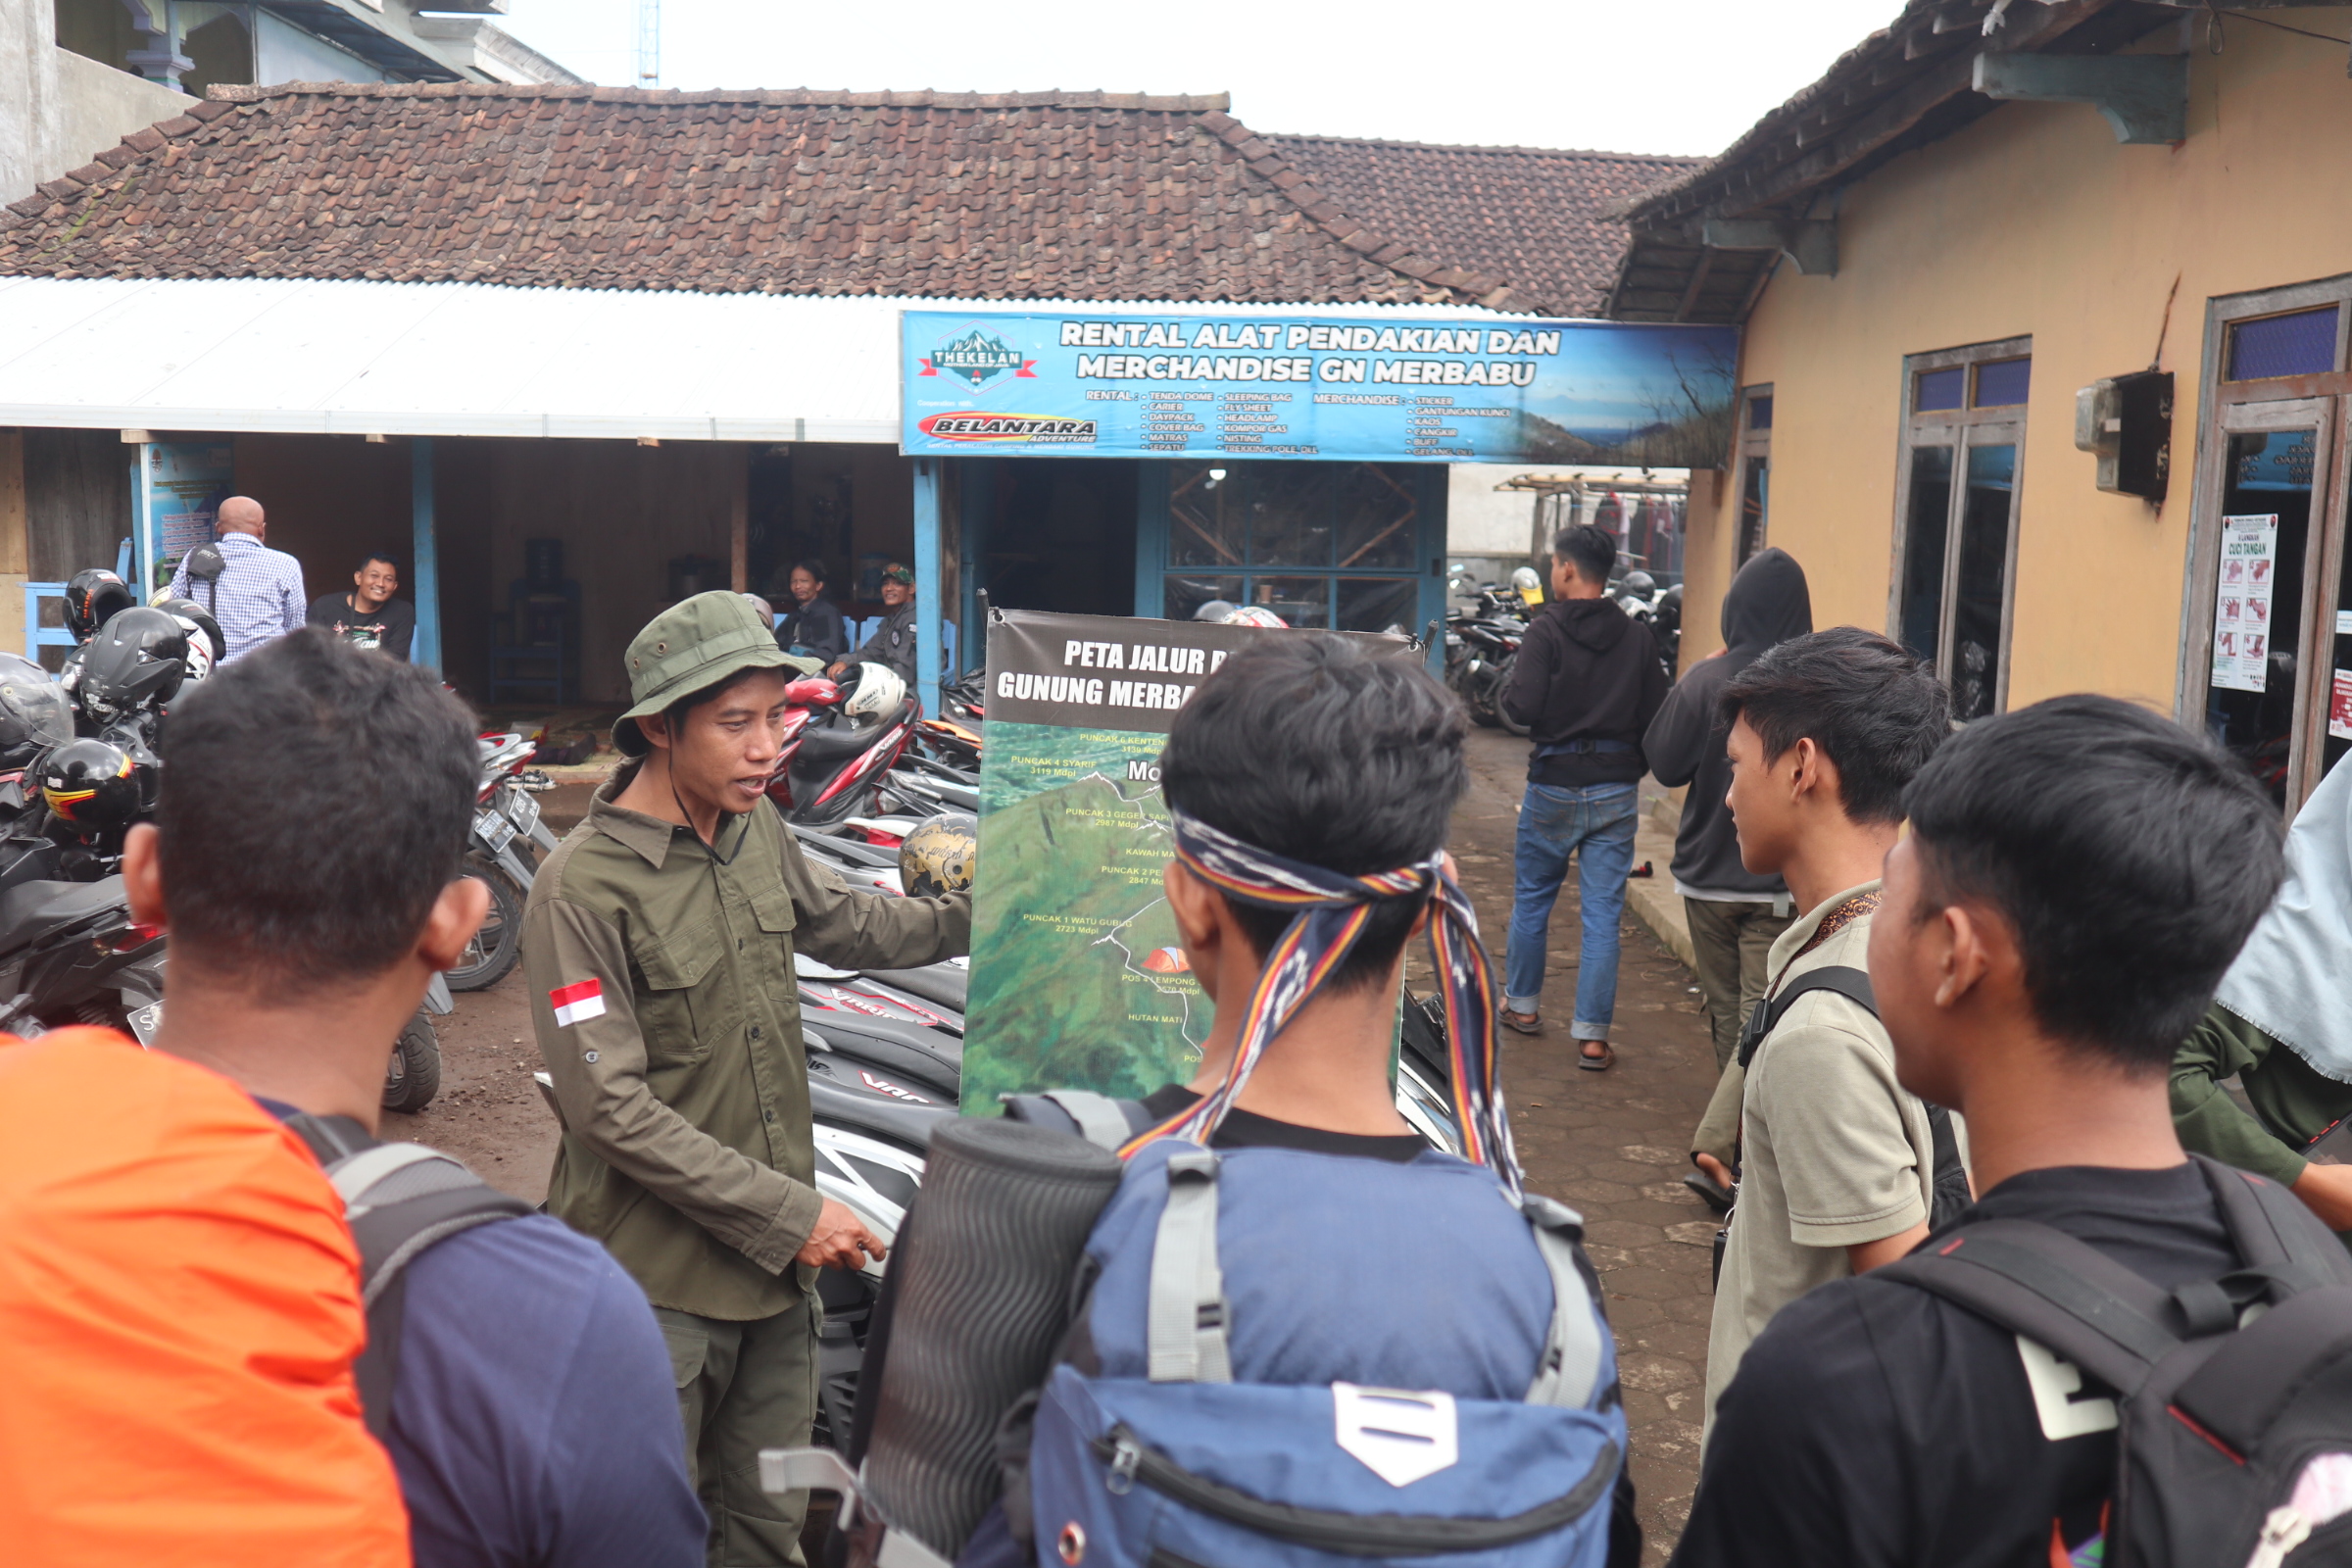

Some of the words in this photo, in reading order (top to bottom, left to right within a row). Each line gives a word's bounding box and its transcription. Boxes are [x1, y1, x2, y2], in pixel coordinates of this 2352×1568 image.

[1060, 320, 1186, 349] RENTAL
[1192, 322, 1283, 351] ALAT
[1287, 324, 1480, 355] PENDAKIAN
[1487, 329, 1561, 357] DAN
[934, 351, 1020, 364] THEKELAN
[1077, 354, 1311, 382] MERCHANDISE
[1318, 358, 1367, 383] GN
[1374, 360, 1536, 387] MERBABU
[1086, 390, 1133, 401] RENTAL
[1149, 392, 1183, 401] TENDA
[1183, 393, 1214, 402] DOME
[1224, 392, 1270, 402] SLEEPING
[1271, 393, 1292, 402] BAG
[1312, 394, 1400, 405] MERCHANDISE
[1414, 396, 1454, 406] STICKER
[1149, 403, 1184, 412] CARIER
[1224, 403, 1242, 412] FLY
[1242, 403, 1273, 413] SHEET
[1414, 407, 1478, 416] GANTUNGAN
[1479, 408, 1511, 417] KUNCI
[1149, 413, 1196, 421] DAYPACK
[1224, 414, 1279, 422] HEADLAMP
[1414, 417, 1442, 426] KAOS
[929, 418, 1098, 435] BELANTARA
[1148, 422, 1183, 432] COVER
[1183, 423, 1205, 432] BAG
[1224, 423, 1266, 433] KOMPOR
[1267, 424, 1288, 433] GAS
[1148, 433, 1189, 442] MATRAS
[1413, 428, 1458, 437] CANGKIR
[1028, 434, 1098, 443] ADVENTURE
[1223, 433, 1262, 443] NISTING
[1148, 443, 1185, 452] SEPATU
[1224, 444, 1271, 454] TREKKING
[2243, 543, 2267, 556] TANGAN
[1063, 640, 1124, 669] PETA
[1128, 645, 1205, 674] JALUR
[997, 671, 1103, 705] GUNUNG
[1079, 733, 1118, 743] PUNCAK
[1144, 747, 1163, 756] Mdp
[1010, 755, 1052, 765] PUNCAK
[1062, 759, 1098, 768] SYARIF
[1030, 766, 1052, 775] 3119
[1053, 767, 1076, 777] Mdpl
[1065, 808, 1104, 817] PUNCAK
[1117, 820, 1139, 830] Mdpl
[1101, 865, 1140, 875] PUNCAK
[1023, 913, 1061, 923] PUNCAK
[1071, 916, 1097, 925] WATU
[1055, 924, 1076, 933] 2723
[1078, 926, 1099, 936] Mdpl
[1151, 976, 1196, 986] EMPONG
[1179, 987, 1200, 996] Mdpl
[1128, 1013, 1158, 1022] HUTAN
[1184, 1054, 1203, 1063] POS
